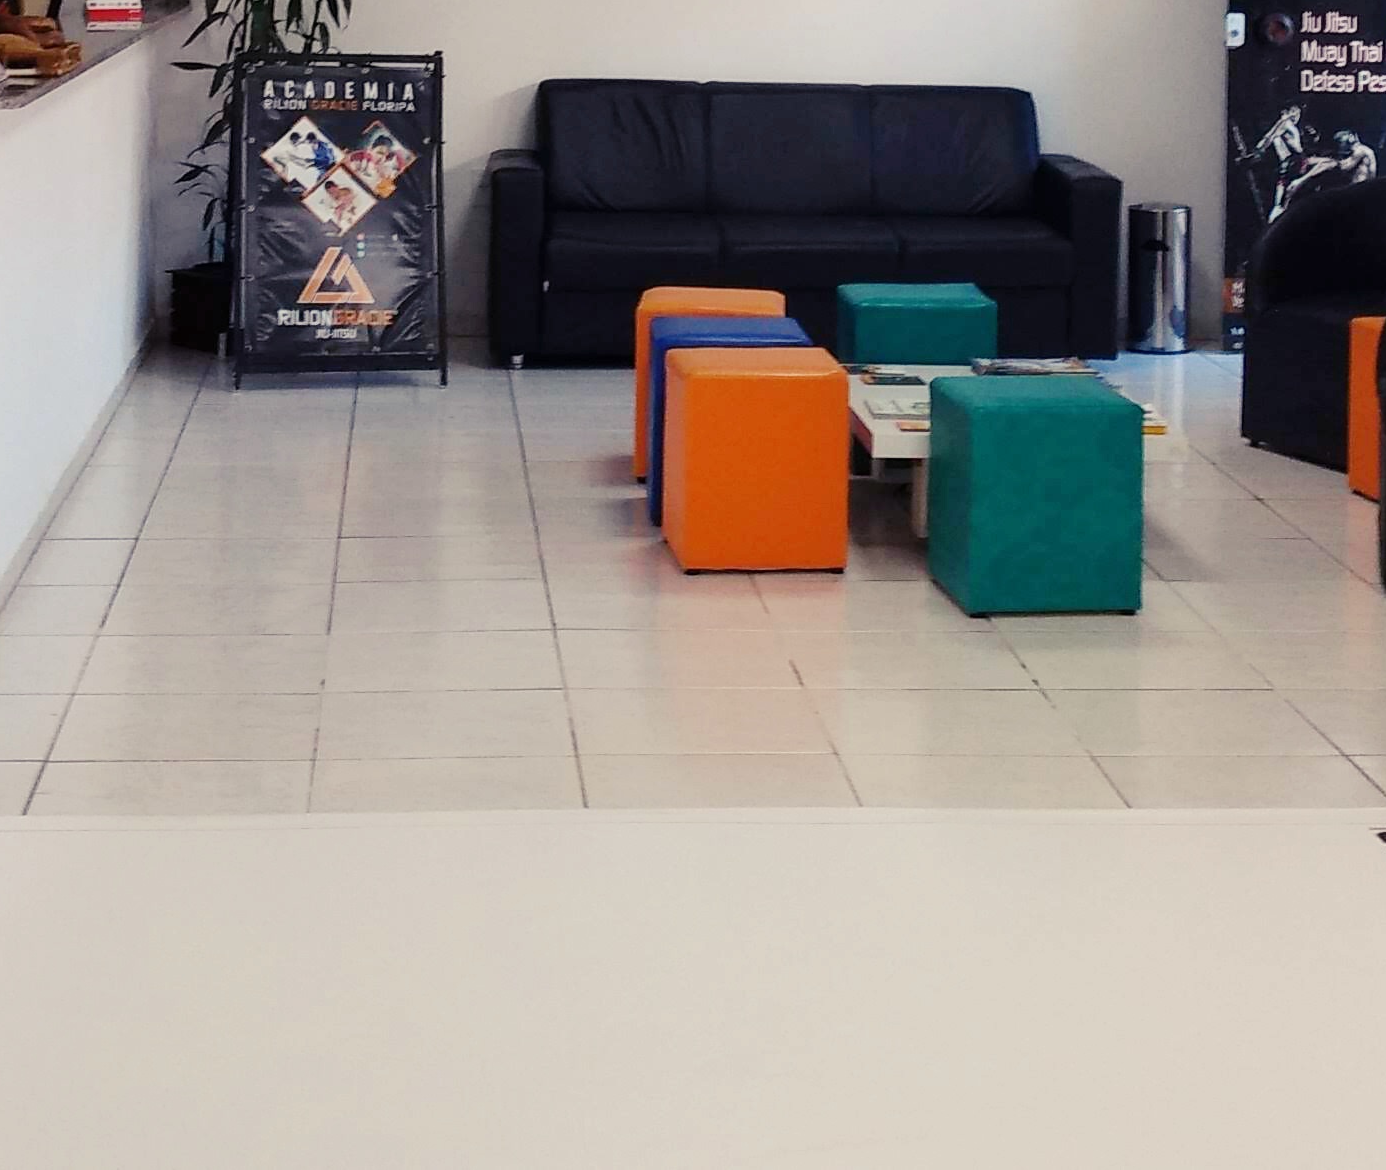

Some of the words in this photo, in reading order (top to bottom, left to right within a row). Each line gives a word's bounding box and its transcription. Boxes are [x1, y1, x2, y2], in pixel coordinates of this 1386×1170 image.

[1301, 11, 1322, 34] Jiu
[1323, 11, 1358, 34] Jitsu
[1301, 41, 1347, 68] Muay
[1349, 41, 1384, 63] Thai
[263, 80, 414, 101] ACADEMIA
[1301, 70, 1355, 92] Defesa
[263, 98, 307, 111] RILION
[310, 99, 358, 111] GRACIE
[362, 100, 415, 112] FLORIPA
